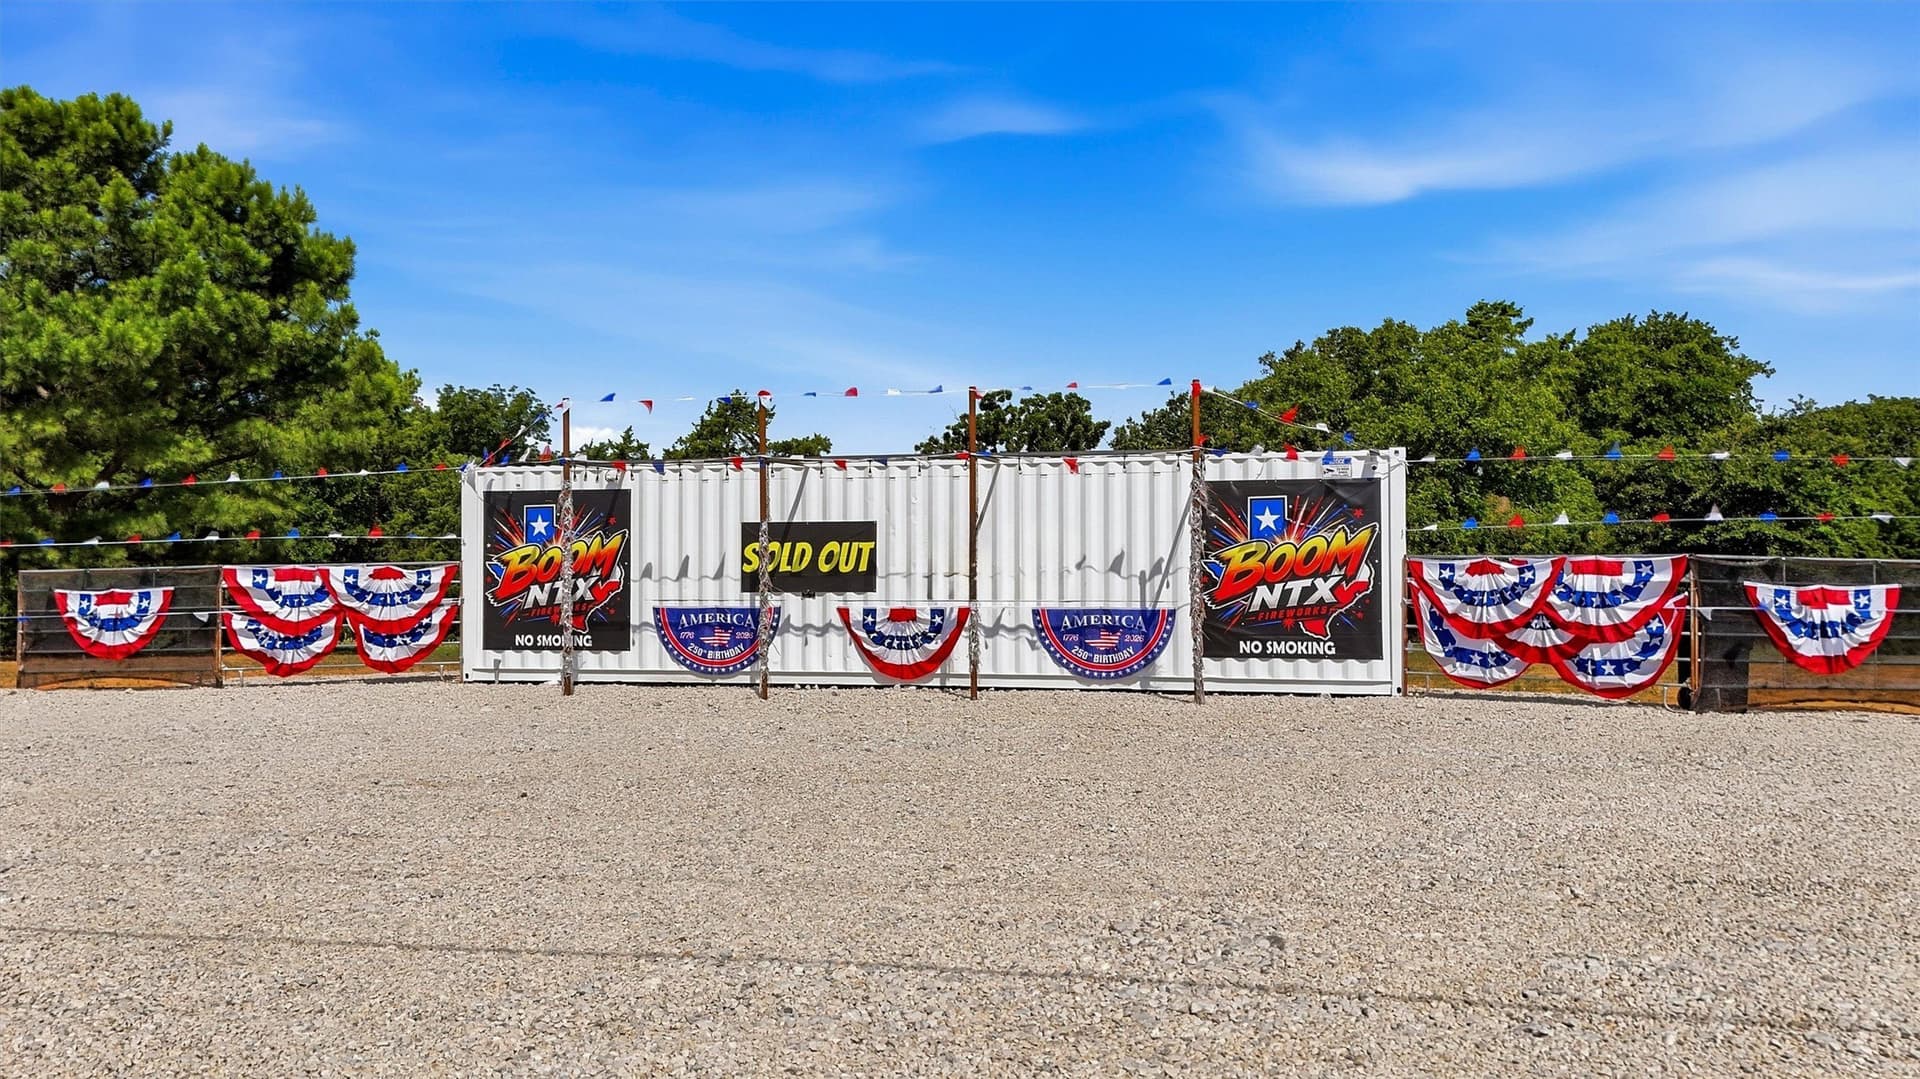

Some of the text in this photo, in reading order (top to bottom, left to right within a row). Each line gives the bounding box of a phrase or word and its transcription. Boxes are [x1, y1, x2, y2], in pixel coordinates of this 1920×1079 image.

[742, 541, 876, 573] SOLD OUT
[1211, 526, 1373, 604] BOOM
[1250, 575, 1344, 612] NTX
[678, 612, 756, 630] AMERICA
[1258, 606, 1328, 620] FIREWORKS
[1060, 614, 1147, 633] AMERICA
[515, 634, 534, 647] NO
[1239, 641, 1336, 655] NO SMOKING
[1093, 646, 1135, 663] BIRTHDAY
